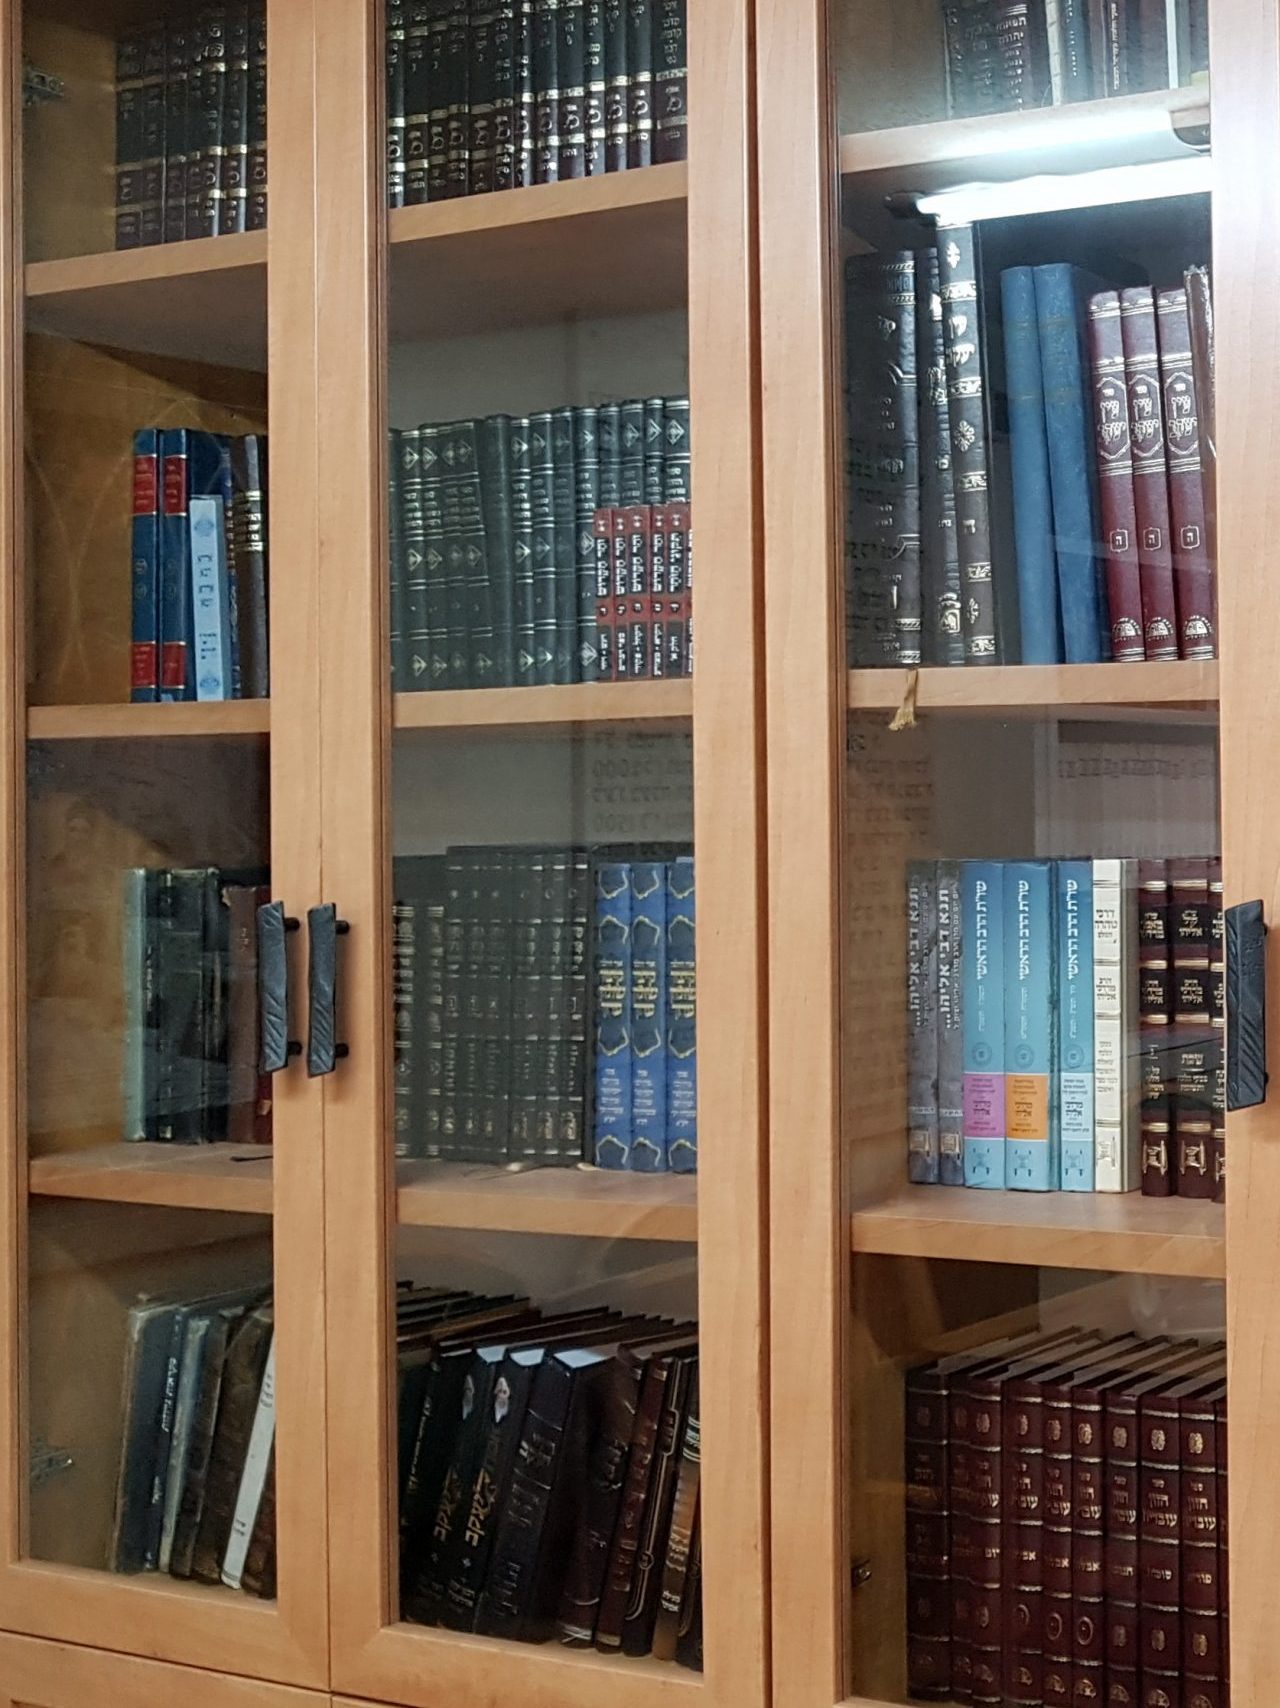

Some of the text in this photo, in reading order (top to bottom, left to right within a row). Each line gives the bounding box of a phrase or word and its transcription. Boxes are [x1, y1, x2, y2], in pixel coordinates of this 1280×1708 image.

[1100, 400, 1120, 423] עין
[1133, 397, 1152, 420] עין
[1171, 395, 1191, 419] עין
[1102, 421, 1126, 445] יעקב
[1131, 419, 1159, 442] יעקב
[1168, 417, 1197, 440] יעקב
[975, 913, 987, 938] הרב
[1018, 913, 1029, 938] הרב
[1066, 913, 1078, 938] הרב
[1095, 909, 1115, 919] דרכי
[975, 939, 988, 980] הראשי
[1018, 939, 1030, 980] הראשי
[1066, 939, 1079, 980] הראשי
[1181, 1053, 1203, 1065] שבת
[1148, 1493, 1169, 1508] חזון
